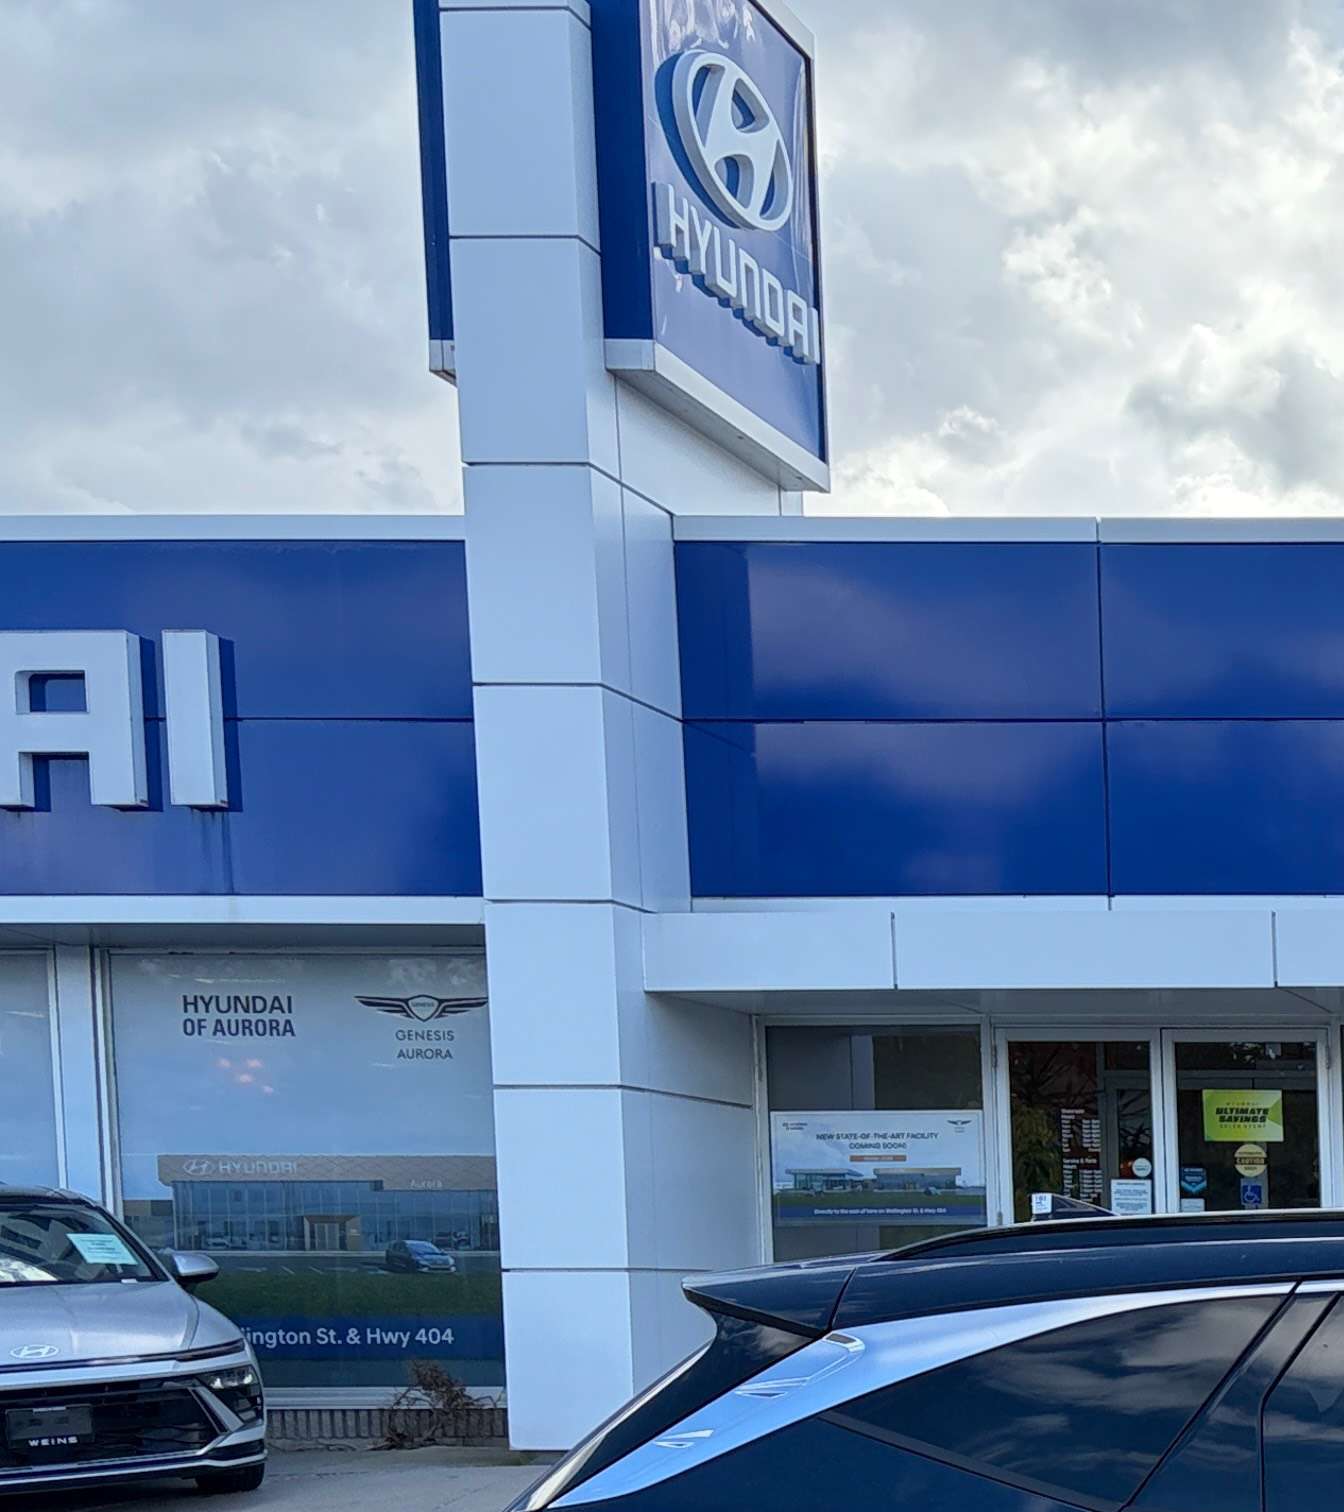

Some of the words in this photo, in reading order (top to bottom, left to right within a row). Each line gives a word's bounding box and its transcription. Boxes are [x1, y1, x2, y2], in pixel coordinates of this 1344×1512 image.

[653, 182, 821, 365] HYUNDAI
[182, 994, 293, 1015] HYUNDAI
[183, 1018, 208, 1037] OF
[212, 1018, 297, 1037] AURORA
[395, 1029, 455, 1042] GENESIS
[396, 1048, 453, 1060] AURORA
[1216, 1107, 1269, 1115] ULTIMATE
[1219, 1115, 1267, 1123] SAVINGS
[816, 1133, 834, 1141] NEW
[906, 1132, 939, 1140] FACILITY
[849, 1142, 881, 1150] COMING
[218, 1161, 298, 1175] HYUNDAI
[316, 1327, 342, 1345] St.
[346, 1328, 361, 1345] &
[366, 1327, 411, 1348] Hwy
[415, 1328, 455, 1345] 404
[28, 1435, 79, 1448] WEINS
